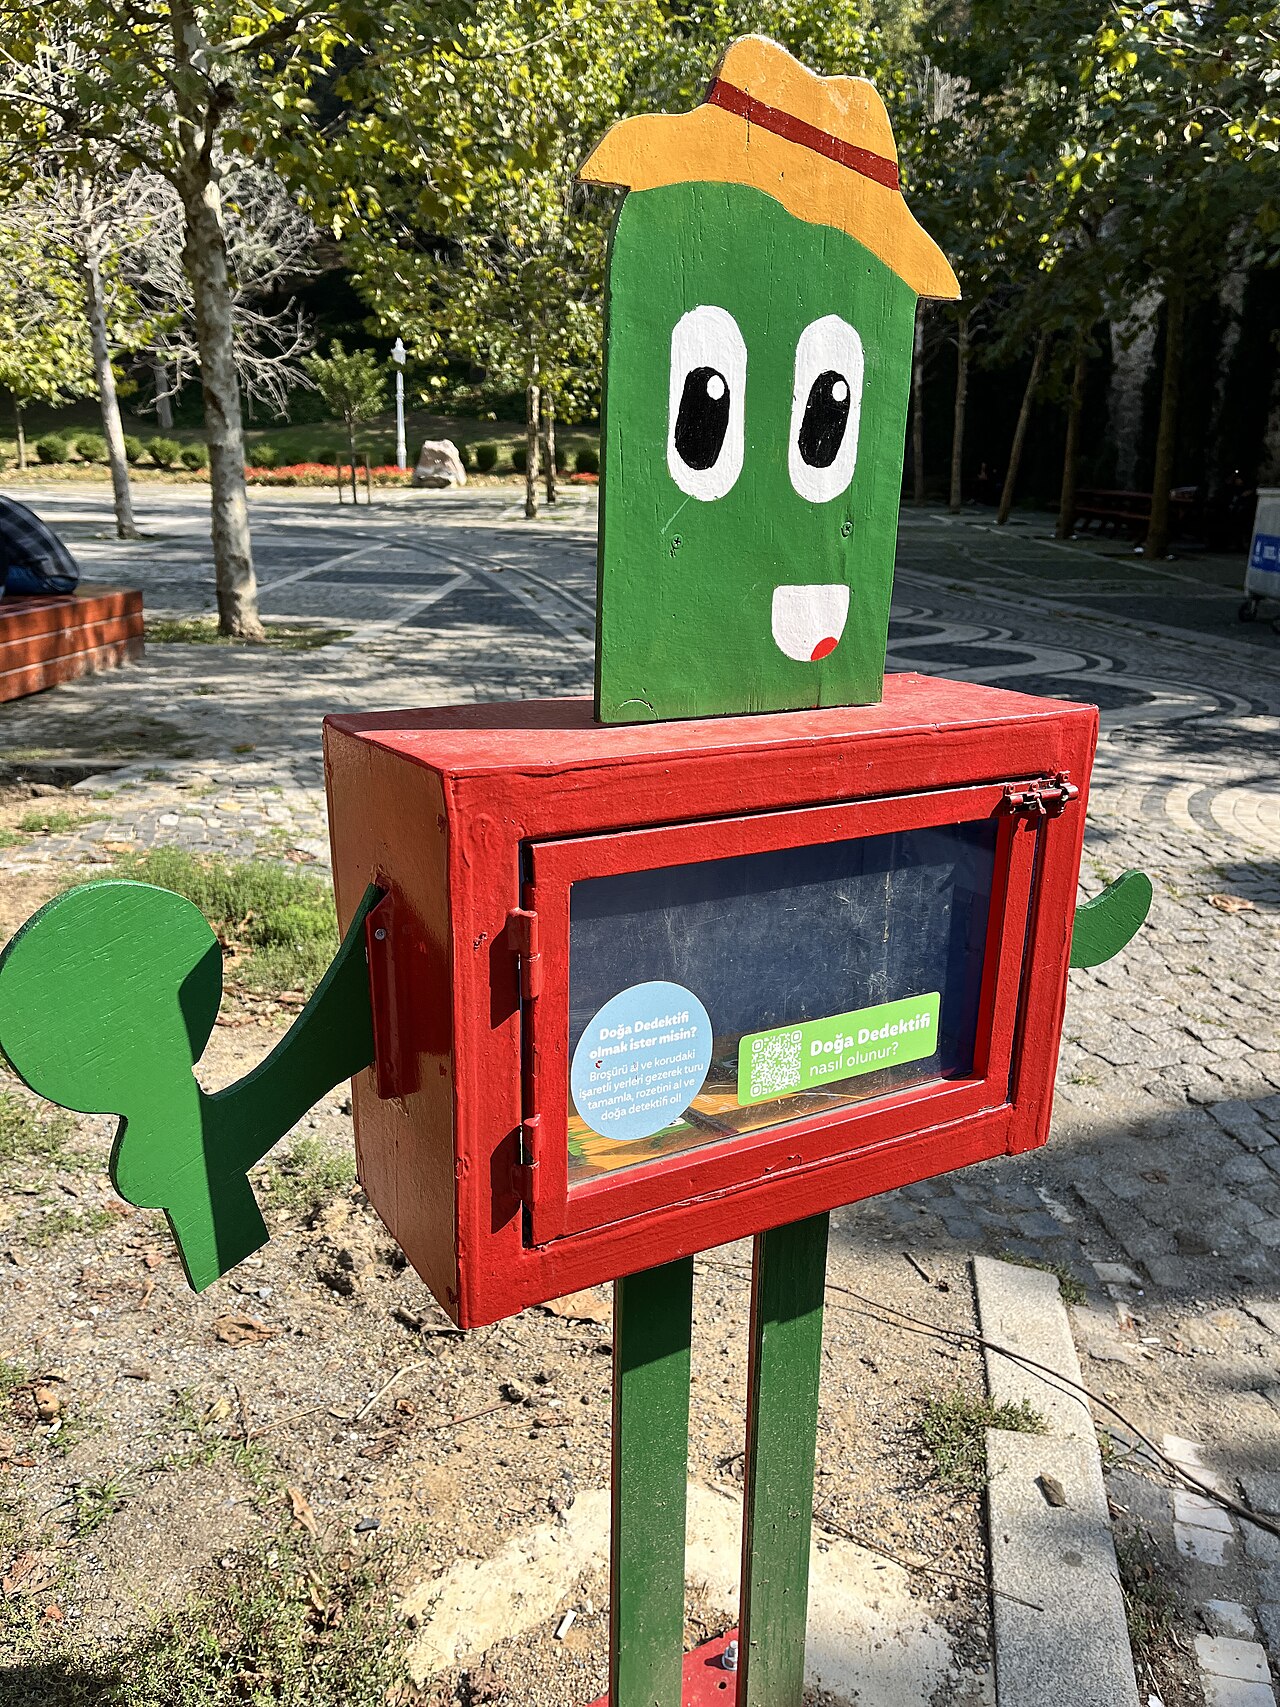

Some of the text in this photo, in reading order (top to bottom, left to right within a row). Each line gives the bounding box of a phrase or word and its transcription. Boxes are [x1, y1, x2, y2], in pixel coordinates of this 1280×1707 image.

[600, 1011, 689, 1040] Doğa Dedektifi
[810, 1013, 930, 1056] Doğa Dedektifi
[590, 1027, 697, 1059] olmak ister misin?
[590, 1063, 628, 1082] Broşürü
[641, 1060, 652, 1068] ve
[655, 1049, 695, 1066] korudaki
[810, 1042, 898, 1077] nasıl olunur?
[579, 1064, 703, 1100] işaretli yerleri gezerek turu
[588, 1093, 633, 1110] tamamla,
[636, 1082, 671, 1099] rozetini
[673, 1078, 682, 1089] al
[601, 1108, 626, 1120] doğa
[629, 1097, 667, 1113] detektifi
